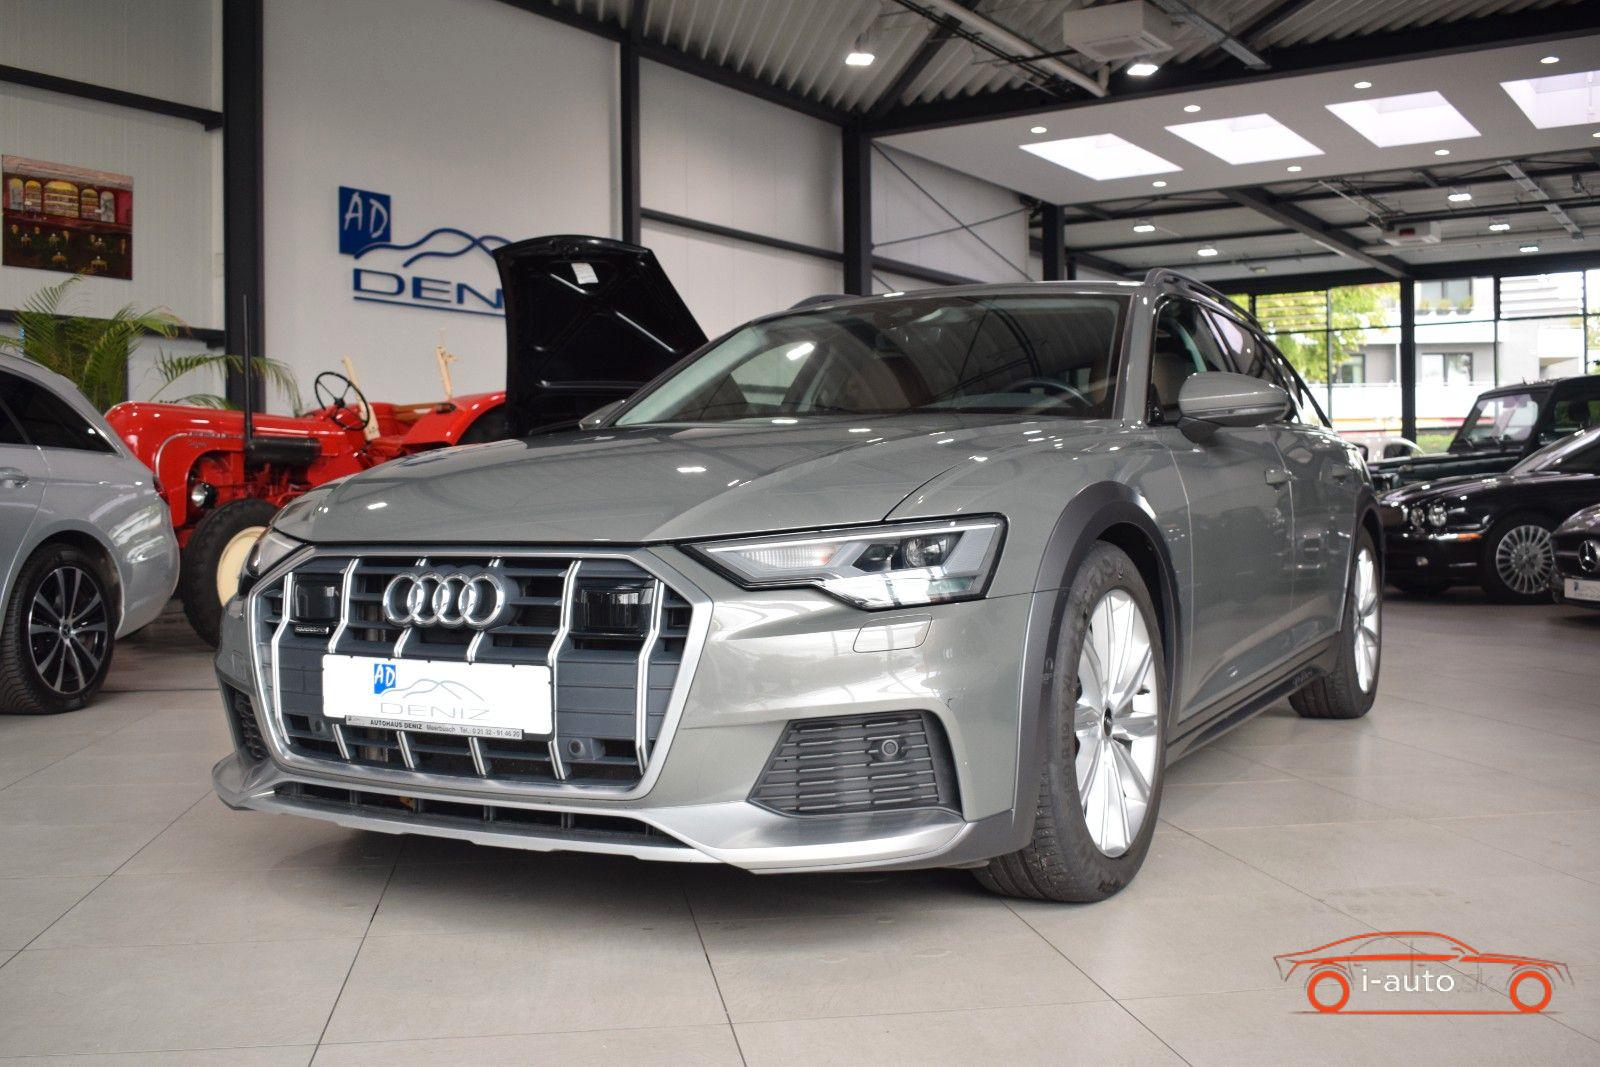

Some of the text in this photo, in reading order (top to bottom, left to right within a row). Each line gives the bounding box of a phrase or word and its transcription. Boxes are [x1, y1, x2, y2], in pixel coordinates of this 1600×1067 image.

[344, 191, 388, 238] AD
[374, 664, 395, 687] AD
[380, 702, 490, 721] DENIZ
[370, 719, 403, 729] AUTOHAUS
[404, 722, 422, 730] DENIZ
